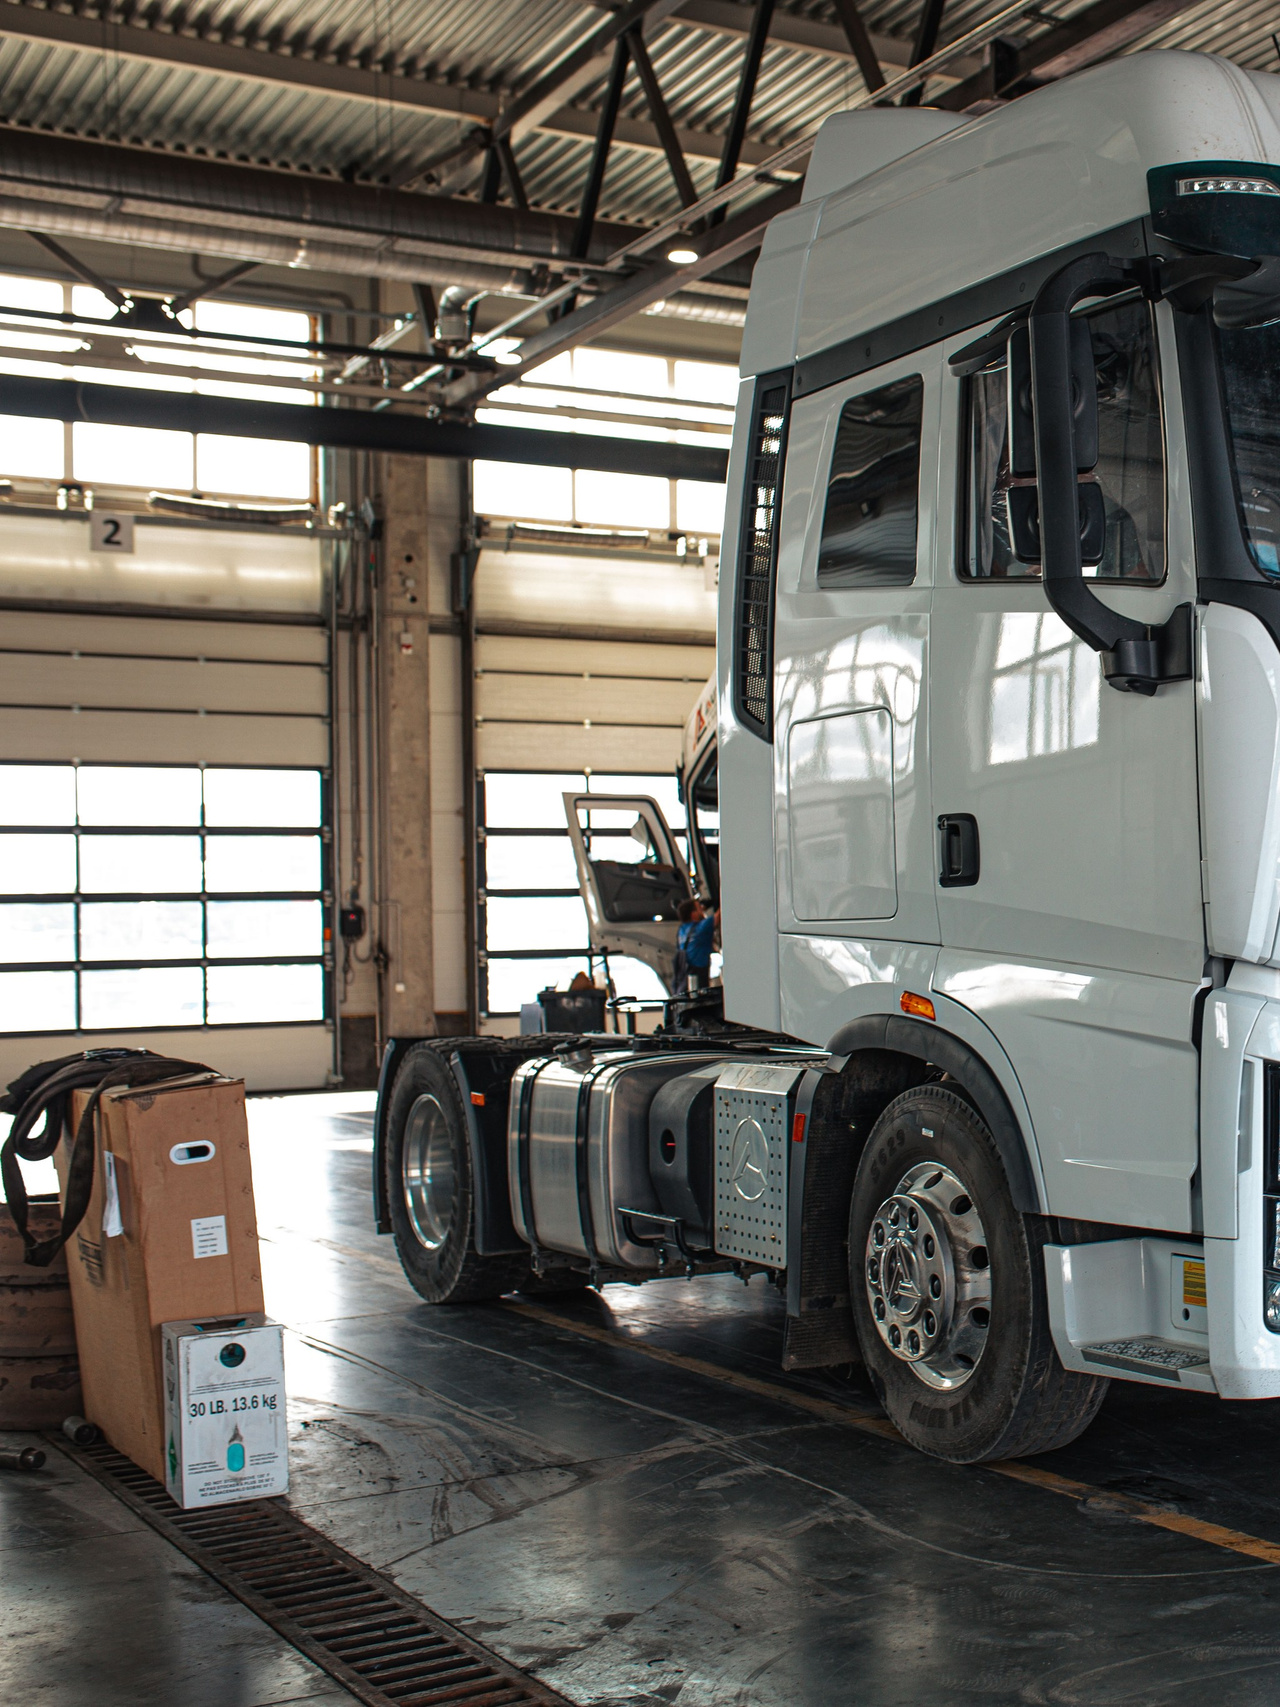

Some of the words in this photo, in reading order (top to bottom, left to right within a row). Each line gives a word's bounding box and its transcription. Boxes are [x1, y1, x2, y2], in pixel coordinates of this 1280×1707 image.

[102, 518, 122, 546] 2
[189, 1402, 205, 1417] 30
[210, 1400, 228, 1415] LB.
[232, 1395, 259, 1412] 13.6
[262, 1393, 277, 1410] kg
